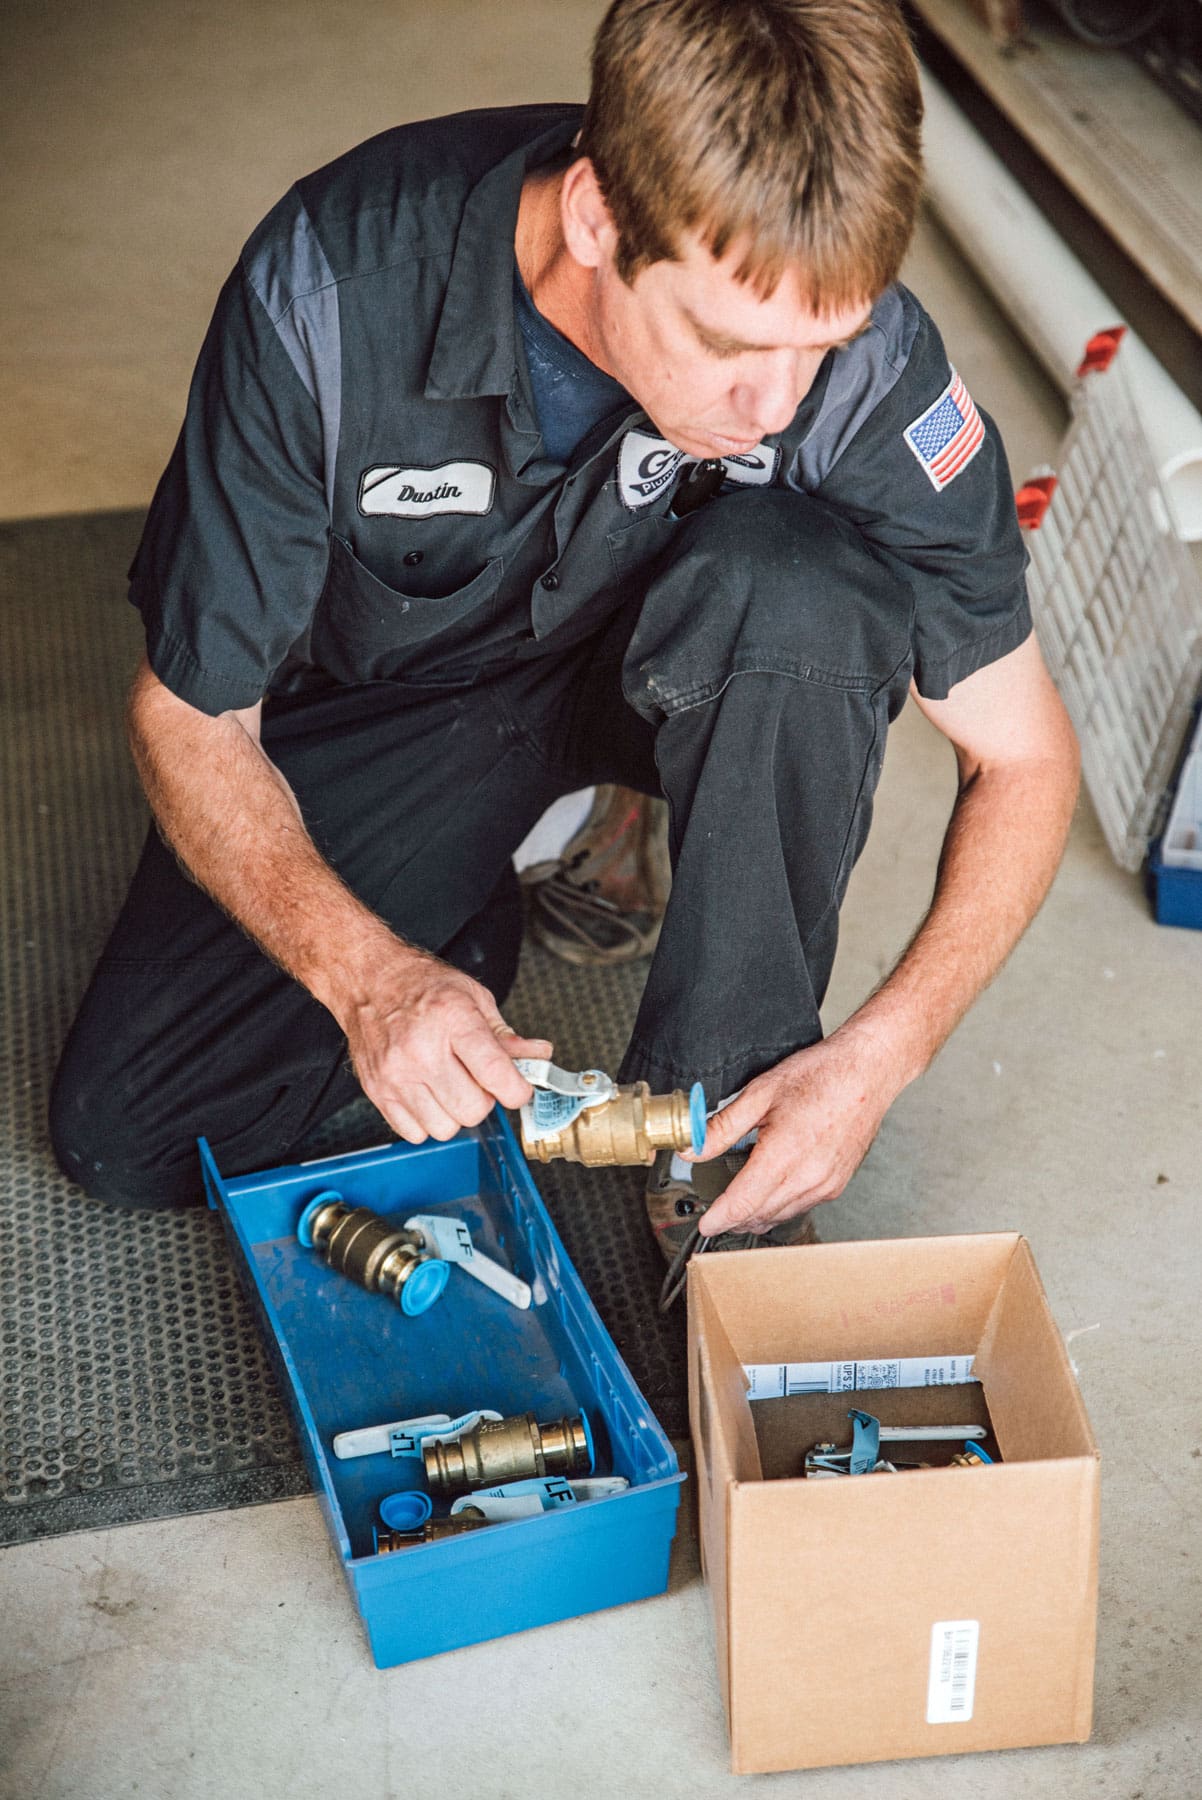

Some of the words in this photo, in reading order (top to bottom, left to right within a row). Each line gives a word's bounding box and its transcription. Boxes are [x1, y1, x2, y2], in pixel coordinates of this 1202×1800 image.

[641, 467, 678, 494] Plum
[397, 482, 462, 503] Dustin
[456, 1227, 473, 1257] LF
[842, 1364, 853, 1382] UPS
[393, 1433, 416, 1452] LF
[543, 1480, 574, 1502] LF
